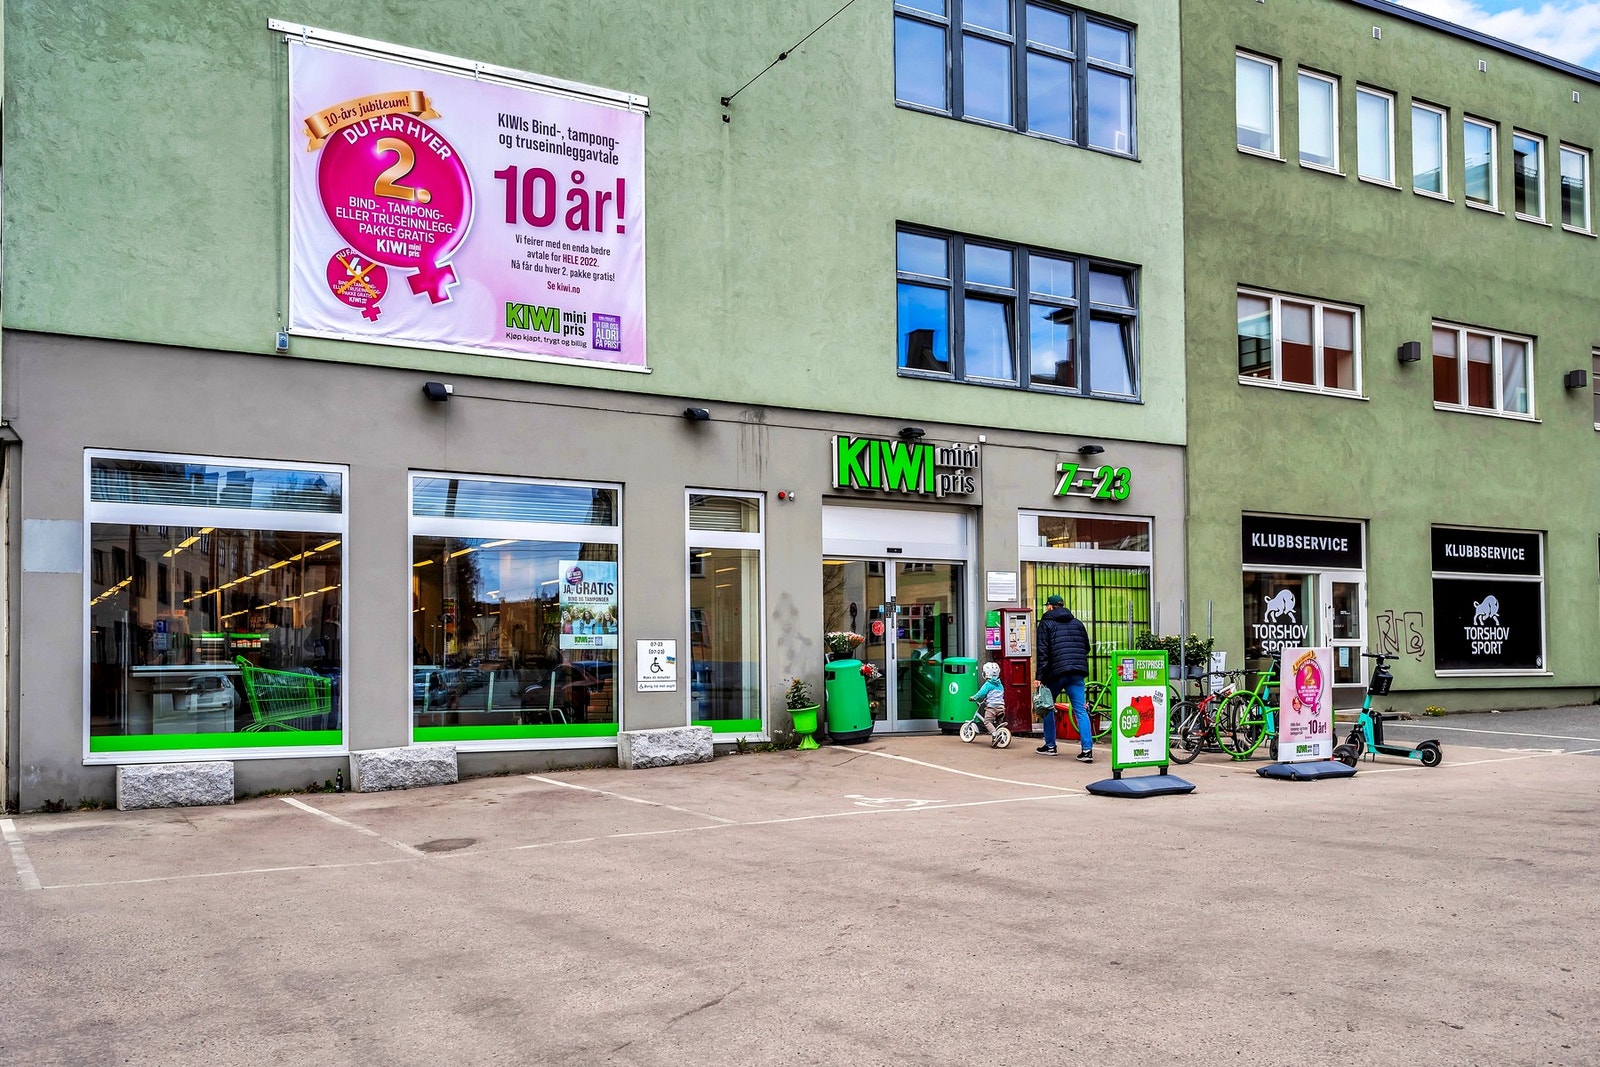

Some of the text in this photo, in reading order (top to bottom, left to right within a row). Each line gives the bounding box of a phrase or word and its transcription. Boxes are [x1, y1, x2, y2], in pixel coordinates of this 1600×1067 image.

[324, 96, 410, 128] 10-års jubileum!
[342, 115, 452, 160] DU FÅR HVER
[498, 112, 620, 150] KIWIs Bind-, tampong-
[498, 134, 620, 166] og truseinnleggavtale
[374, 138, 432, 204] 2.
[494, 165, 626, 234] 10 år!
[336, 207, 456, 234] ELLER TRUSEINNLEGG-
[388, 202, 444, 220] TAMPONG-
[359, 223, 434, 244] PAKKE GRATIS
[376, 239, 407, 256] KIWI
[516, 234, 522, 244] Vi
[524, 235, 544, 247] feirer
[545, 240, 560, 249] med
[572, 244, 589, 254] enda
[591, 246, 611, 256] bedre
[527, 250, 599, 268] avtale for HELE 2022.
[511, 260, 615, 282] Nå får du hver 2. pakke gratis!
[547, 281, 581, 294] Se kiwi.no
[506, 302, 561, 334] KIWI
[563, 310, 586, 324] mini
[506, 332, 522, 340] Kjøp
[563, 324, 585, 337] pris
[596, 328, 618, 341] ALDRI
[833, 435, 936, 494] KIWI
[937, 443, 980, 468] mini
[937, 470, 976, 498] pris
[1055, 462, 1132, 500] 7-23
[1252, 532, 1348, 552] KLUBBSERVICE
[1445, 544, 1525, 560] KLUBBSERVICE
[563, 582, 614, 596] JA, GRATIS
[1252, 624, 1308, 639] TORSHOV
[1464, 626, 1510, 640] TORSHOV
[1472, 641, 1503, 655] SPORT
[1137, 660, 1164, 669] FESTPRISER
[1308, 720, 1326, 734] 10 år!
